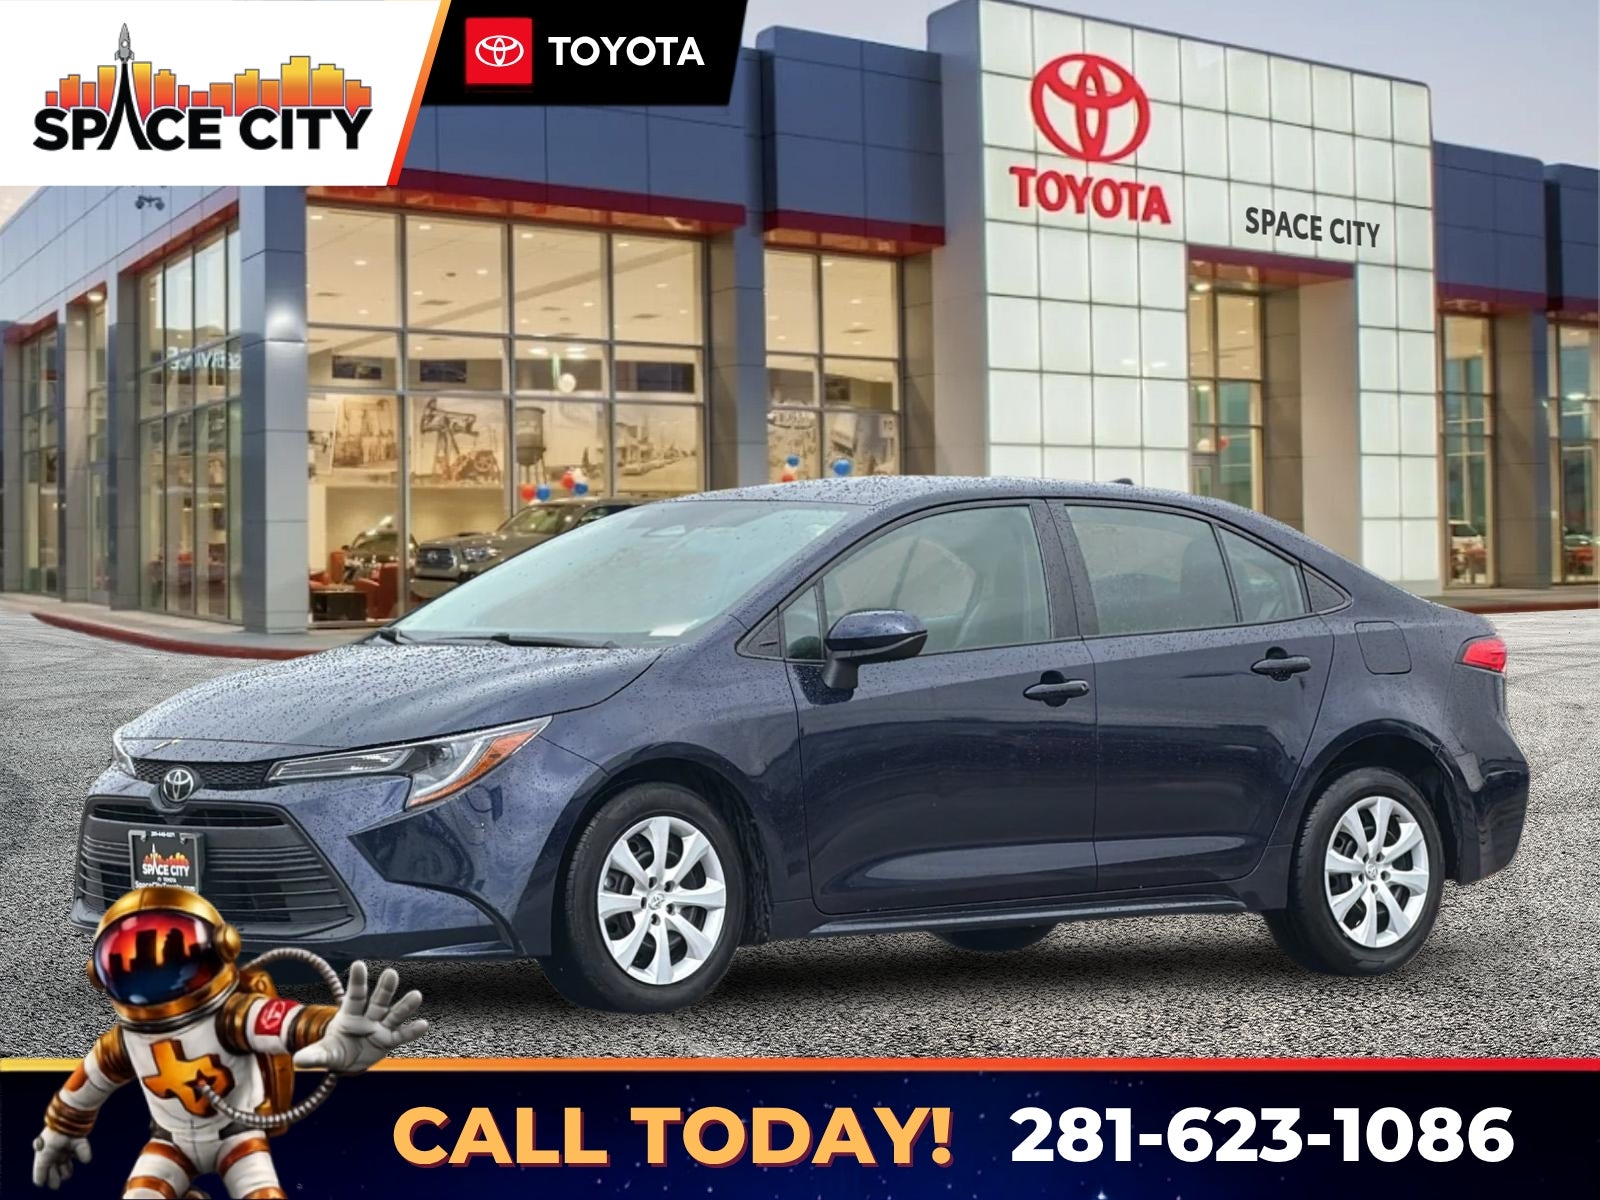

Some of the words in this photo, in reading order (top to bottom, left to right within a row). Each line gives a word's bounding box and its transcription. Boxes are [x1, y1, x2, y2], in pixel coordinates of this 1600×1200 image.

[1009, 165, 1171, 225] TOYOTA
[1245, 206, 1323, 242] SPACE
[1329, 218, 1381, 248] CITY
[142, 863, 169, 876] SPACE
[170, 865, 190, 877] CITY
